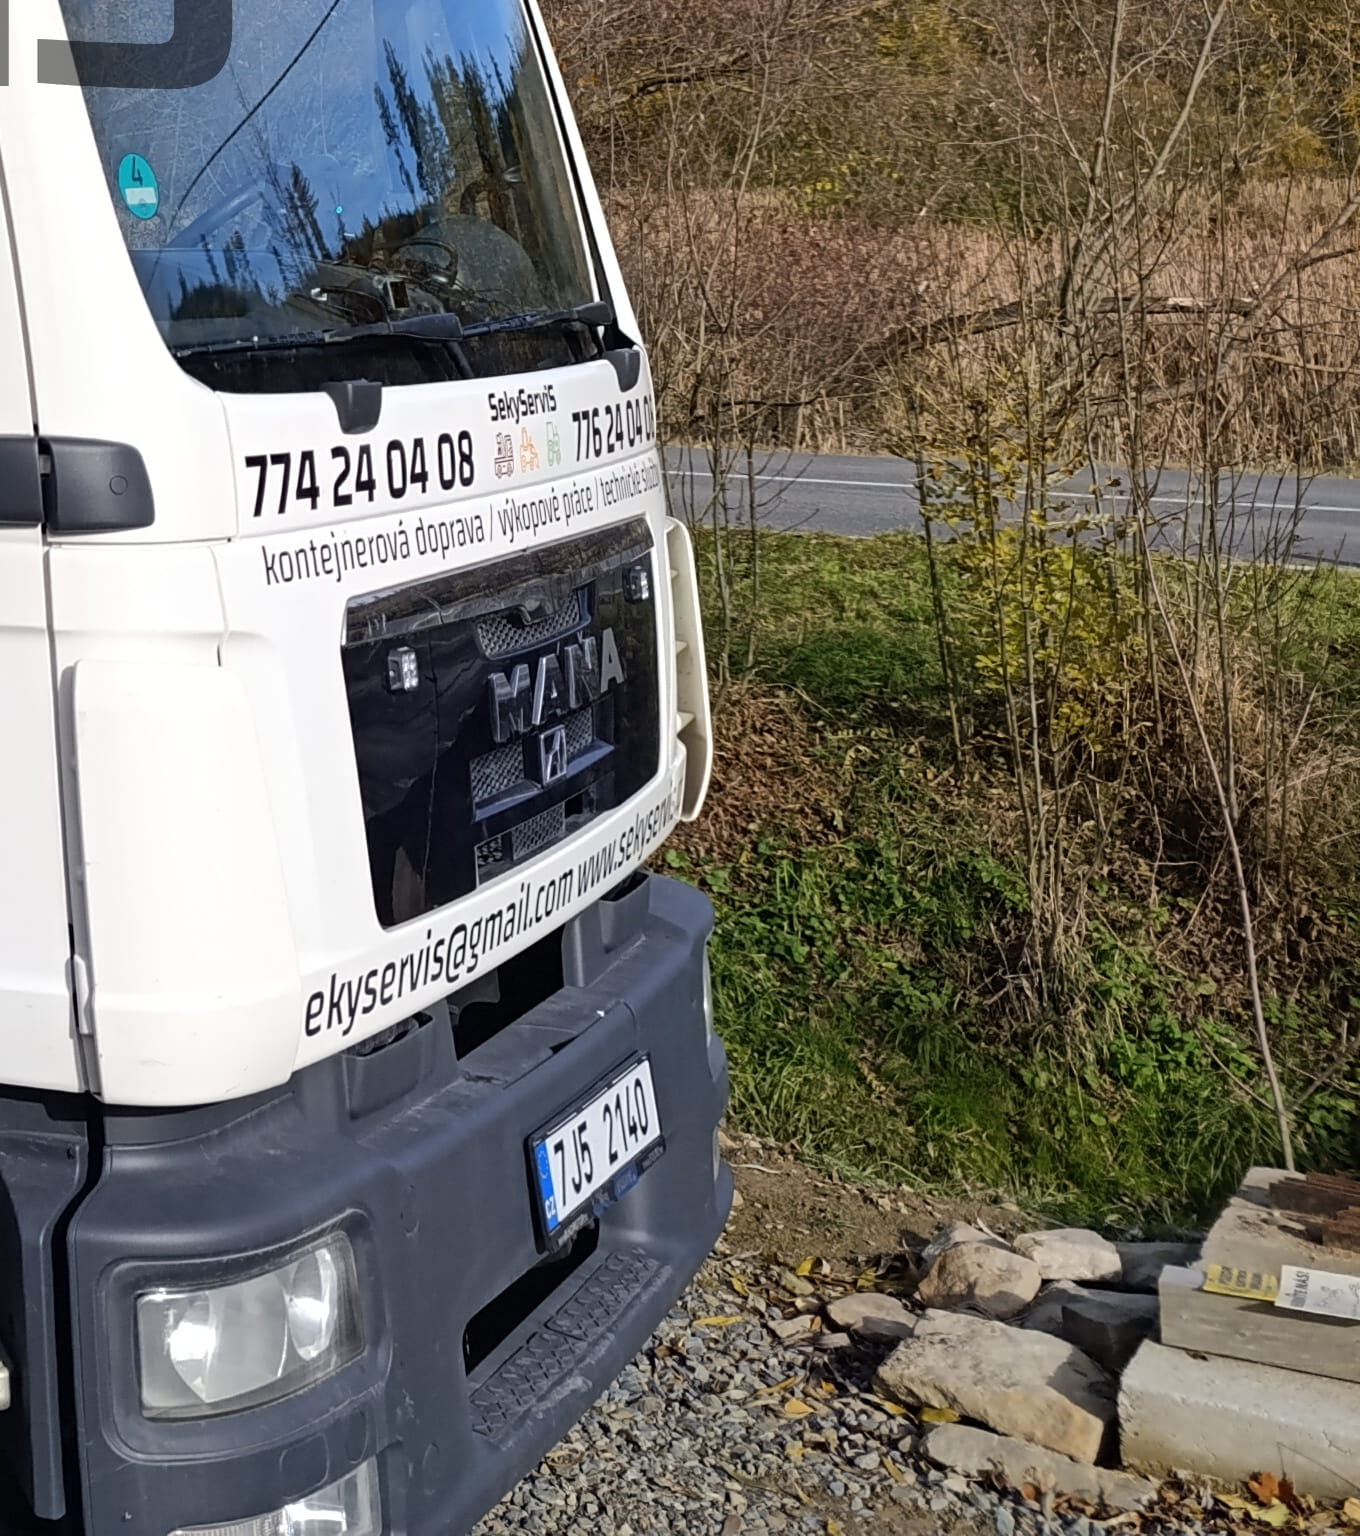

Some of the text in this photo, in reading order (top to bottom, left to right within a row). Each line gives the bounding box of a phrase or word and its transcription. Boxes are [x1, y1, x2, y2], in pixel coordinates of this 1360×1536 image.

[131, 156, 144, 187] 4
[487, 384, 558, 425] SekyServiS
[571, 406, 603, 462] 776
[604, 404, 624, 454] 24
[625, 399, 643, 448] 04
[244, 429, 476, 518] 774 24 04 08
[261, 518, 411, 586] kontejnerová
[414, 516, 485, 560] doprava
[497, 487, 561, 543] výkopové
[562, 480, 594, 526] práce
[599, 462, 642, 507] technické
[304, 867, 574, 1037] ekyservis@gmail.com
[553, 1110, 594, 1207] 7J5
[602, 1077, 649, 1165] 2140
[544, 1185, 557, 1219] CZ
